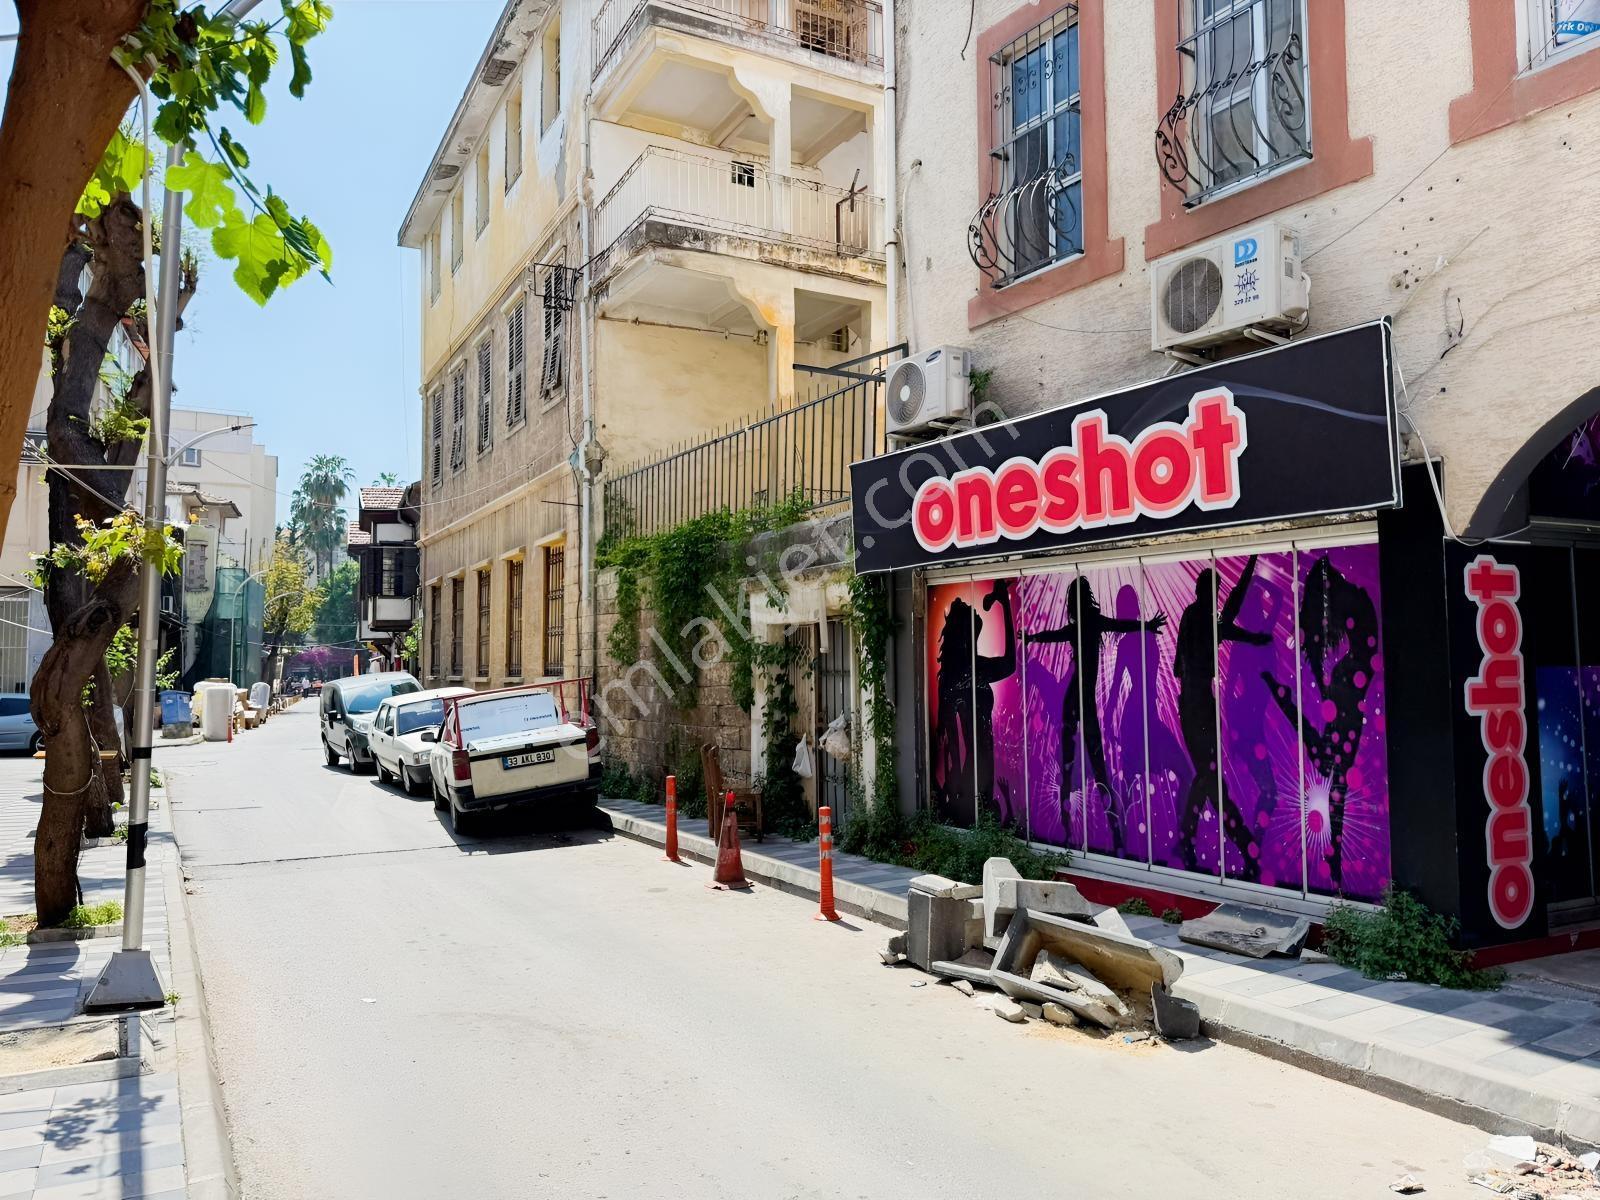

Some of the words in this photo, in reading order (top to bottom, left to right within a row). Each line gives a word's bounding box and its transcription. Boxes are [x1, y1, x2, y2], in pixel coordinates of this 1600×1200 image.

[913, 387, 1247, 552] oneshot
[508, 757, 518, 766] 33
[521, 755, 535, 763] AKL
[1464, 554, 1535, 930] oneshot
